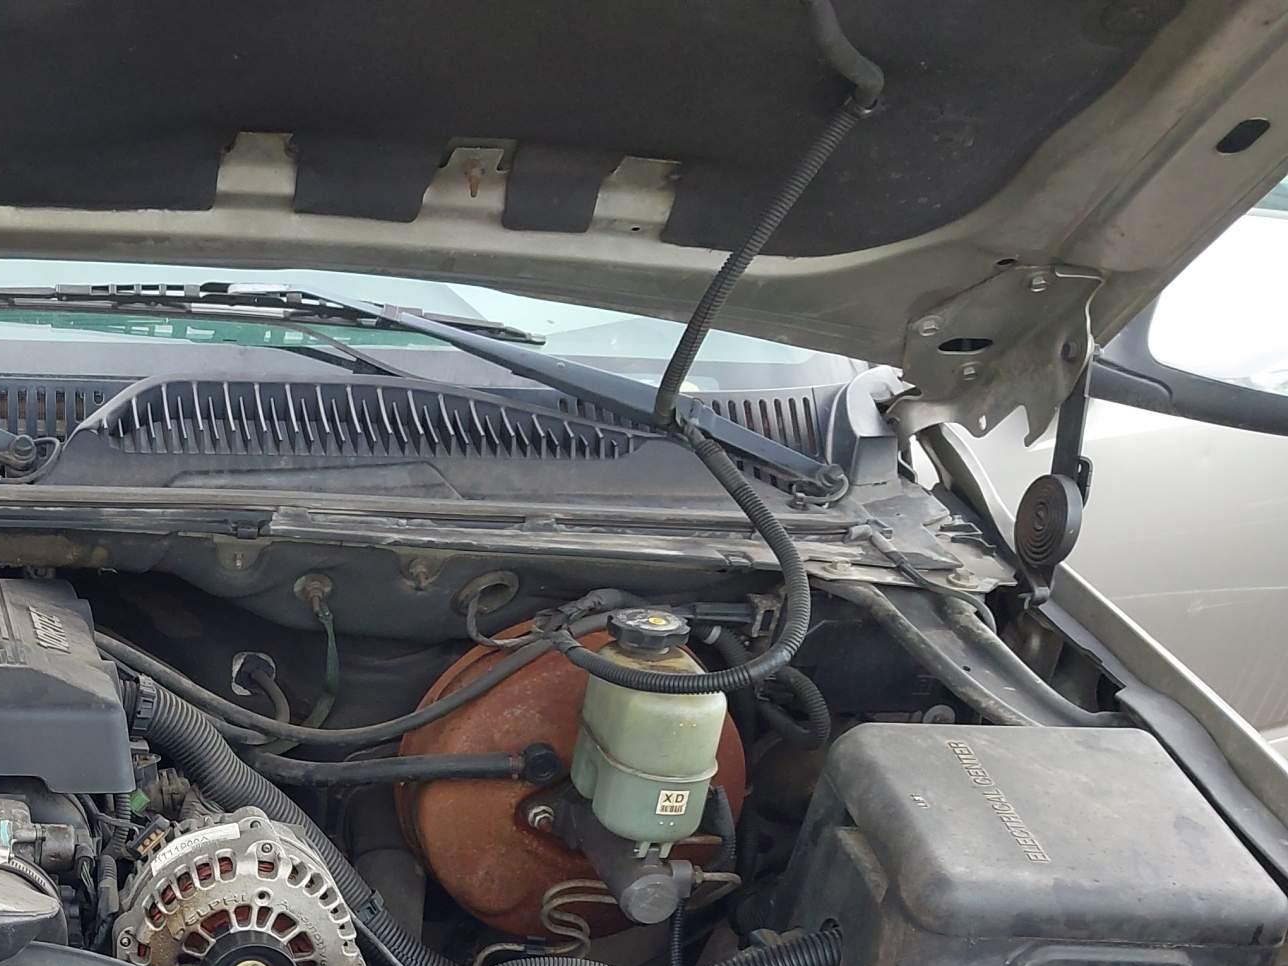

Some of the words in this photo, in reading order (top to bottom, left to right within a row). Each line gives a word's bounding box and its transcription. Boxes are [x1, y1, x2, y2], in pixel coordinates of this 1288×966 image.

[945, 740, 995, 787] CENTER
[982, 788, 1052, 864] ELECTRICAL
[172, 893, 248, 942] DELPHI
